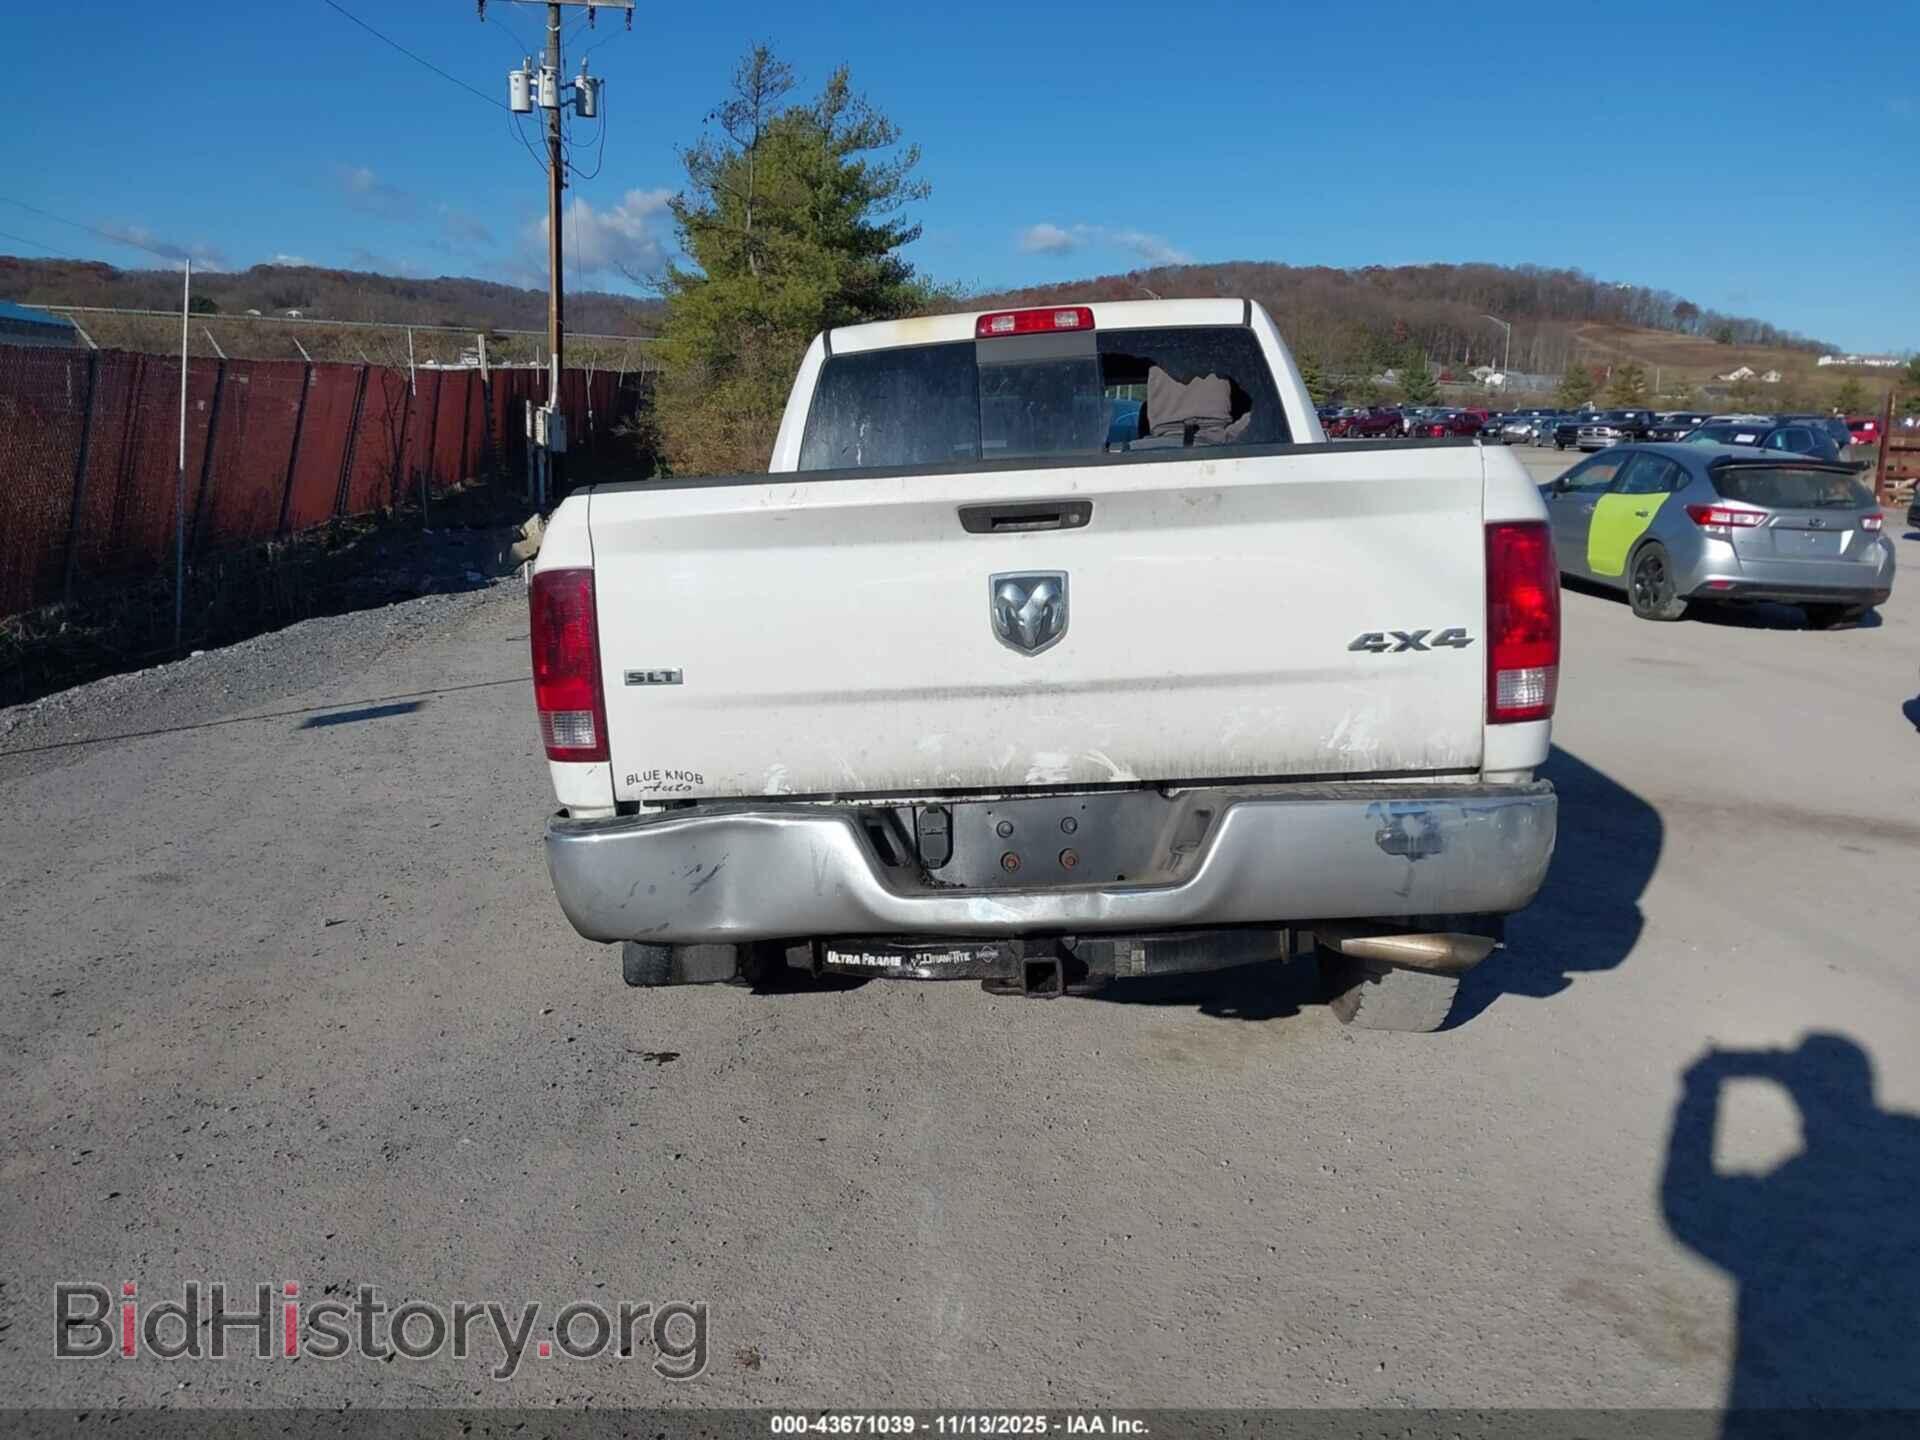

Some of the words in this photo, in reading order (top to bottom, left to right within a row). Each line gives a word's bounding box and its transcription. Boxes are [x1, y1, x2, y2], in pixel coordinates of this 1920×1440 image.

[1348, 627, 1474, 653] 4X4
[627, 671, 677, 684] SLT
[626, 769, 661, 786] BLUE
[665, 769, 705, 785] KNOB
[640, 781, 693, 793] Auto
[827, 950, 861, 965] ULTRA
[862, 953, 902, 967] FRAME
